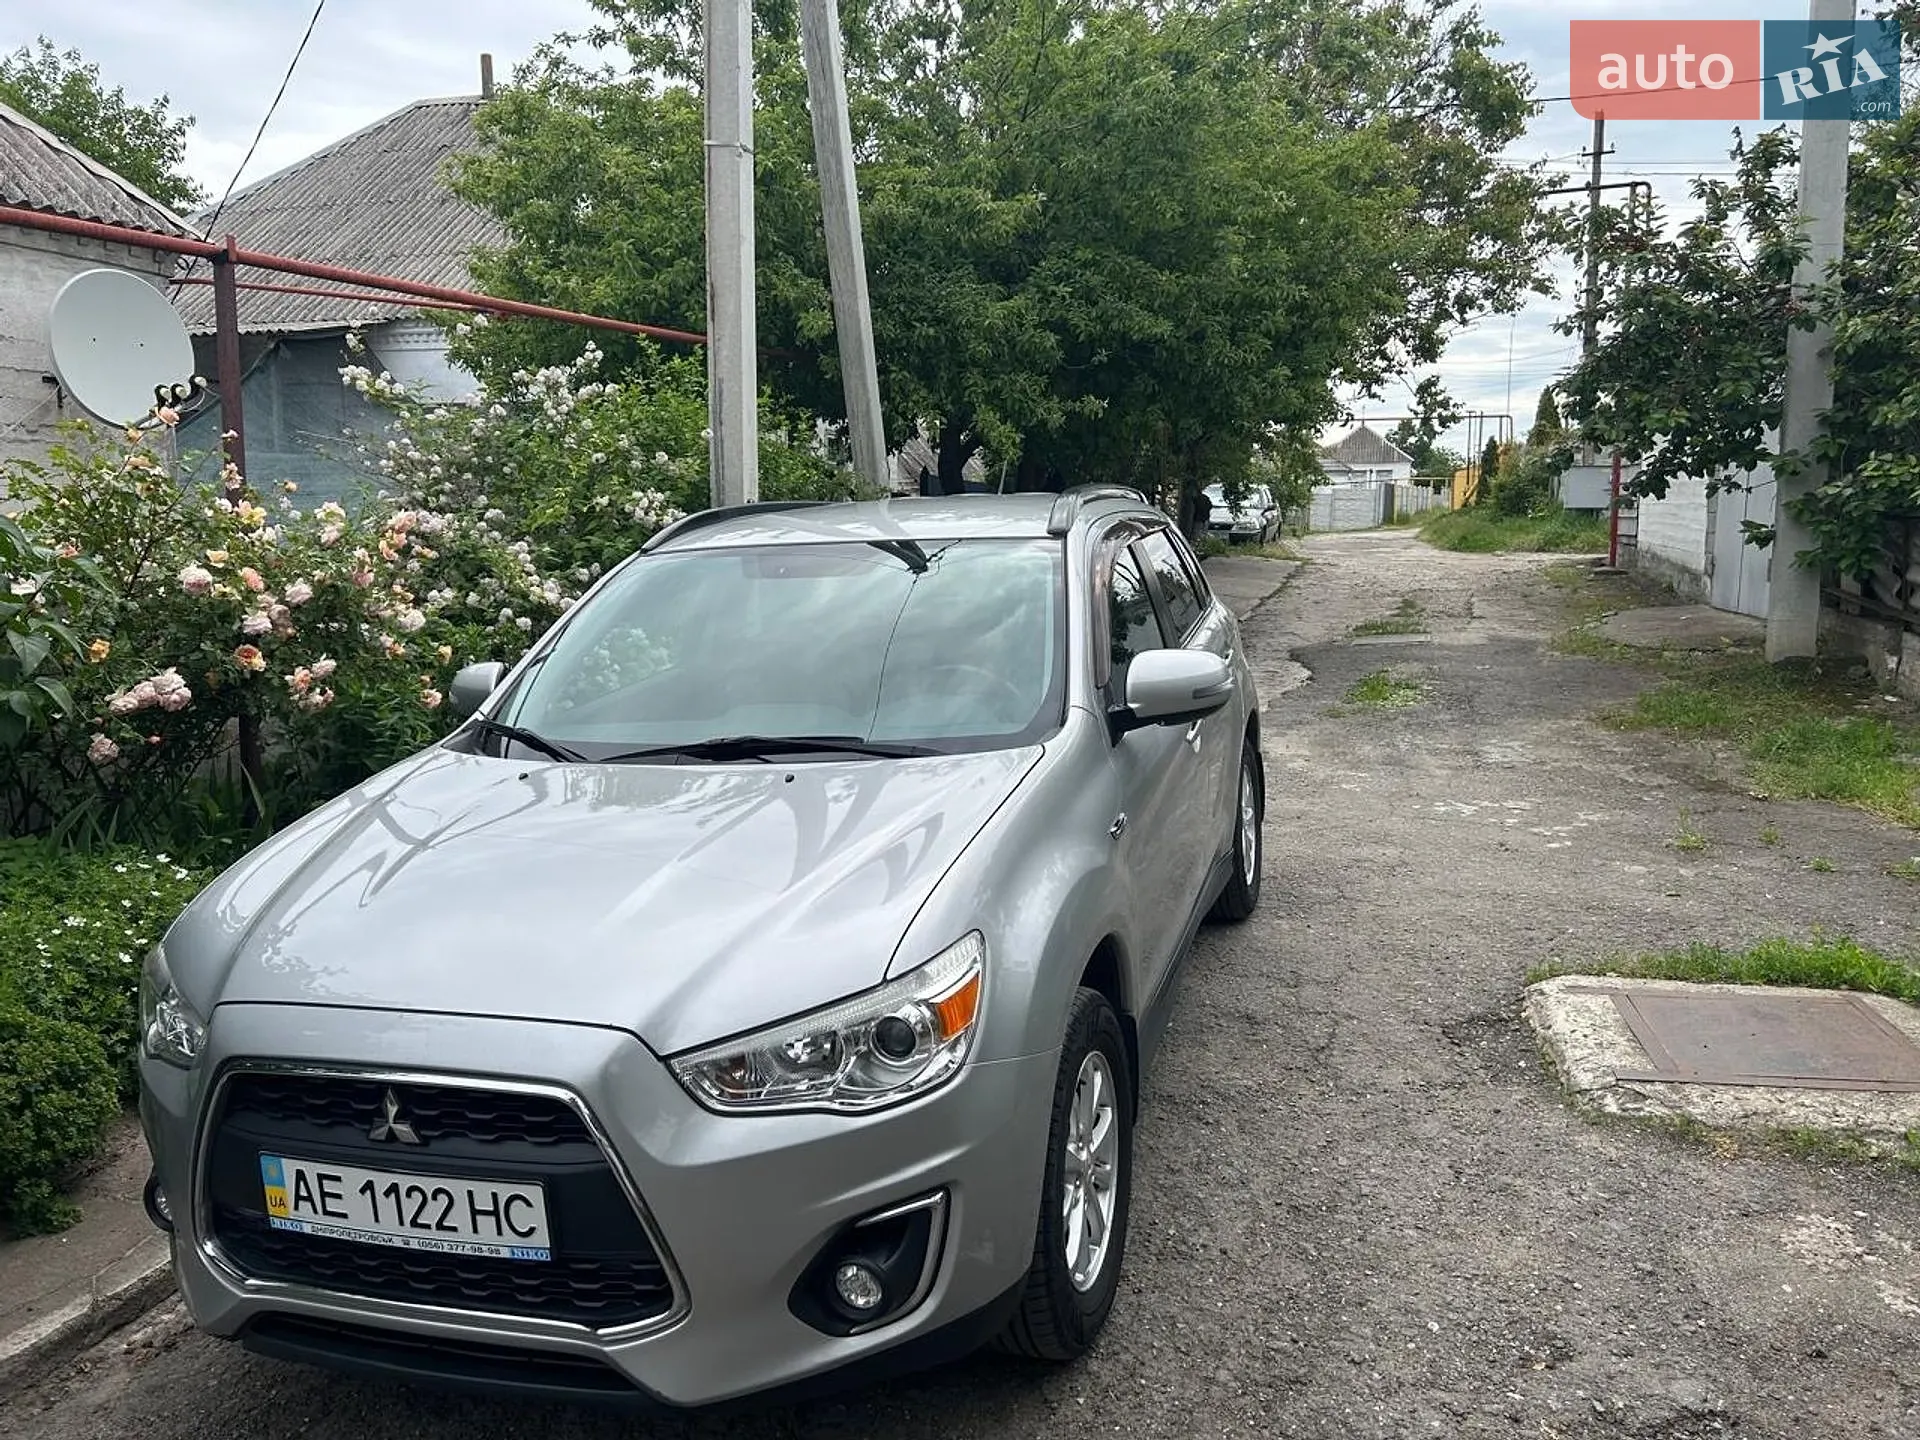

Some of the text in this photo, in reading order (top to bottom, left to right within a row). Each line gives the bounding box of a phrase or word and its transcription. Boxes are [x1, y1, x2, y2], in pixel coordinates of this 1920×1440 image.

[269, 1195, 287, 1209] UA
[293, 1168, 537, 1238] AE 1122 HC
